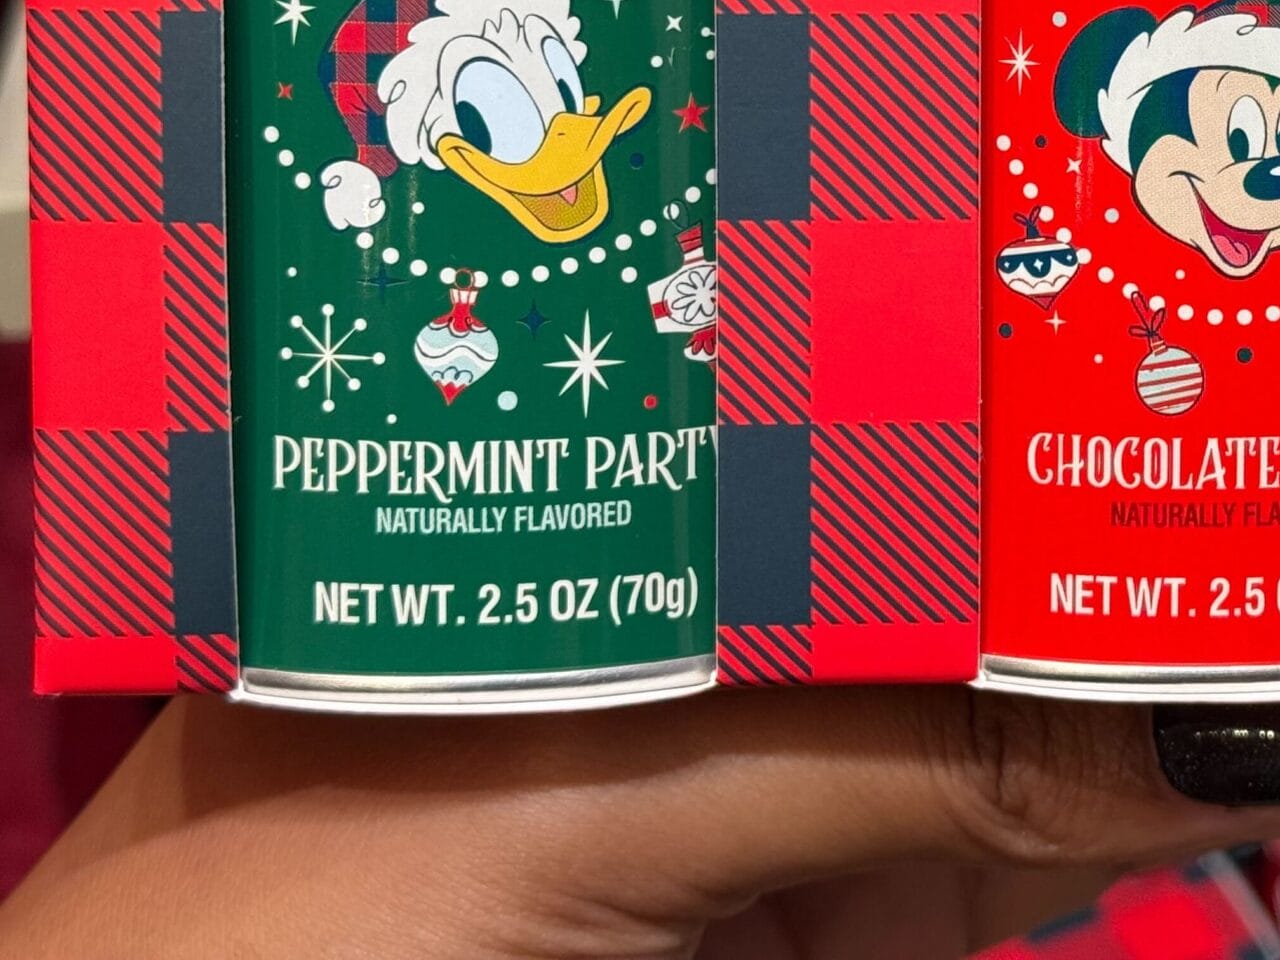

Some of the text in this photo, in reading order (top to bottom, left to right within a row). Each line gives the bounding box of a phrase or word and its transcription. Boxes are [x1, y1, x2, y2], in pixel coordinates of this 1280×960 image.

[273, 425, 717, 503] PEPPERMINT PART
[1027, 432, 1280, 490] CHOCOLATE
[376, 500, 632, 533] NATURALLY FLAVORED
[1110, 502, 1236, 528] NATURALLY
[314, 567, 698, 626] NET WT. 2.5 OZ (70g)
[1050, 572, 1117, 617] NET
[1126, 576, 1196, 617] WT.
[1209, 576, 1265, 618] 2.5
